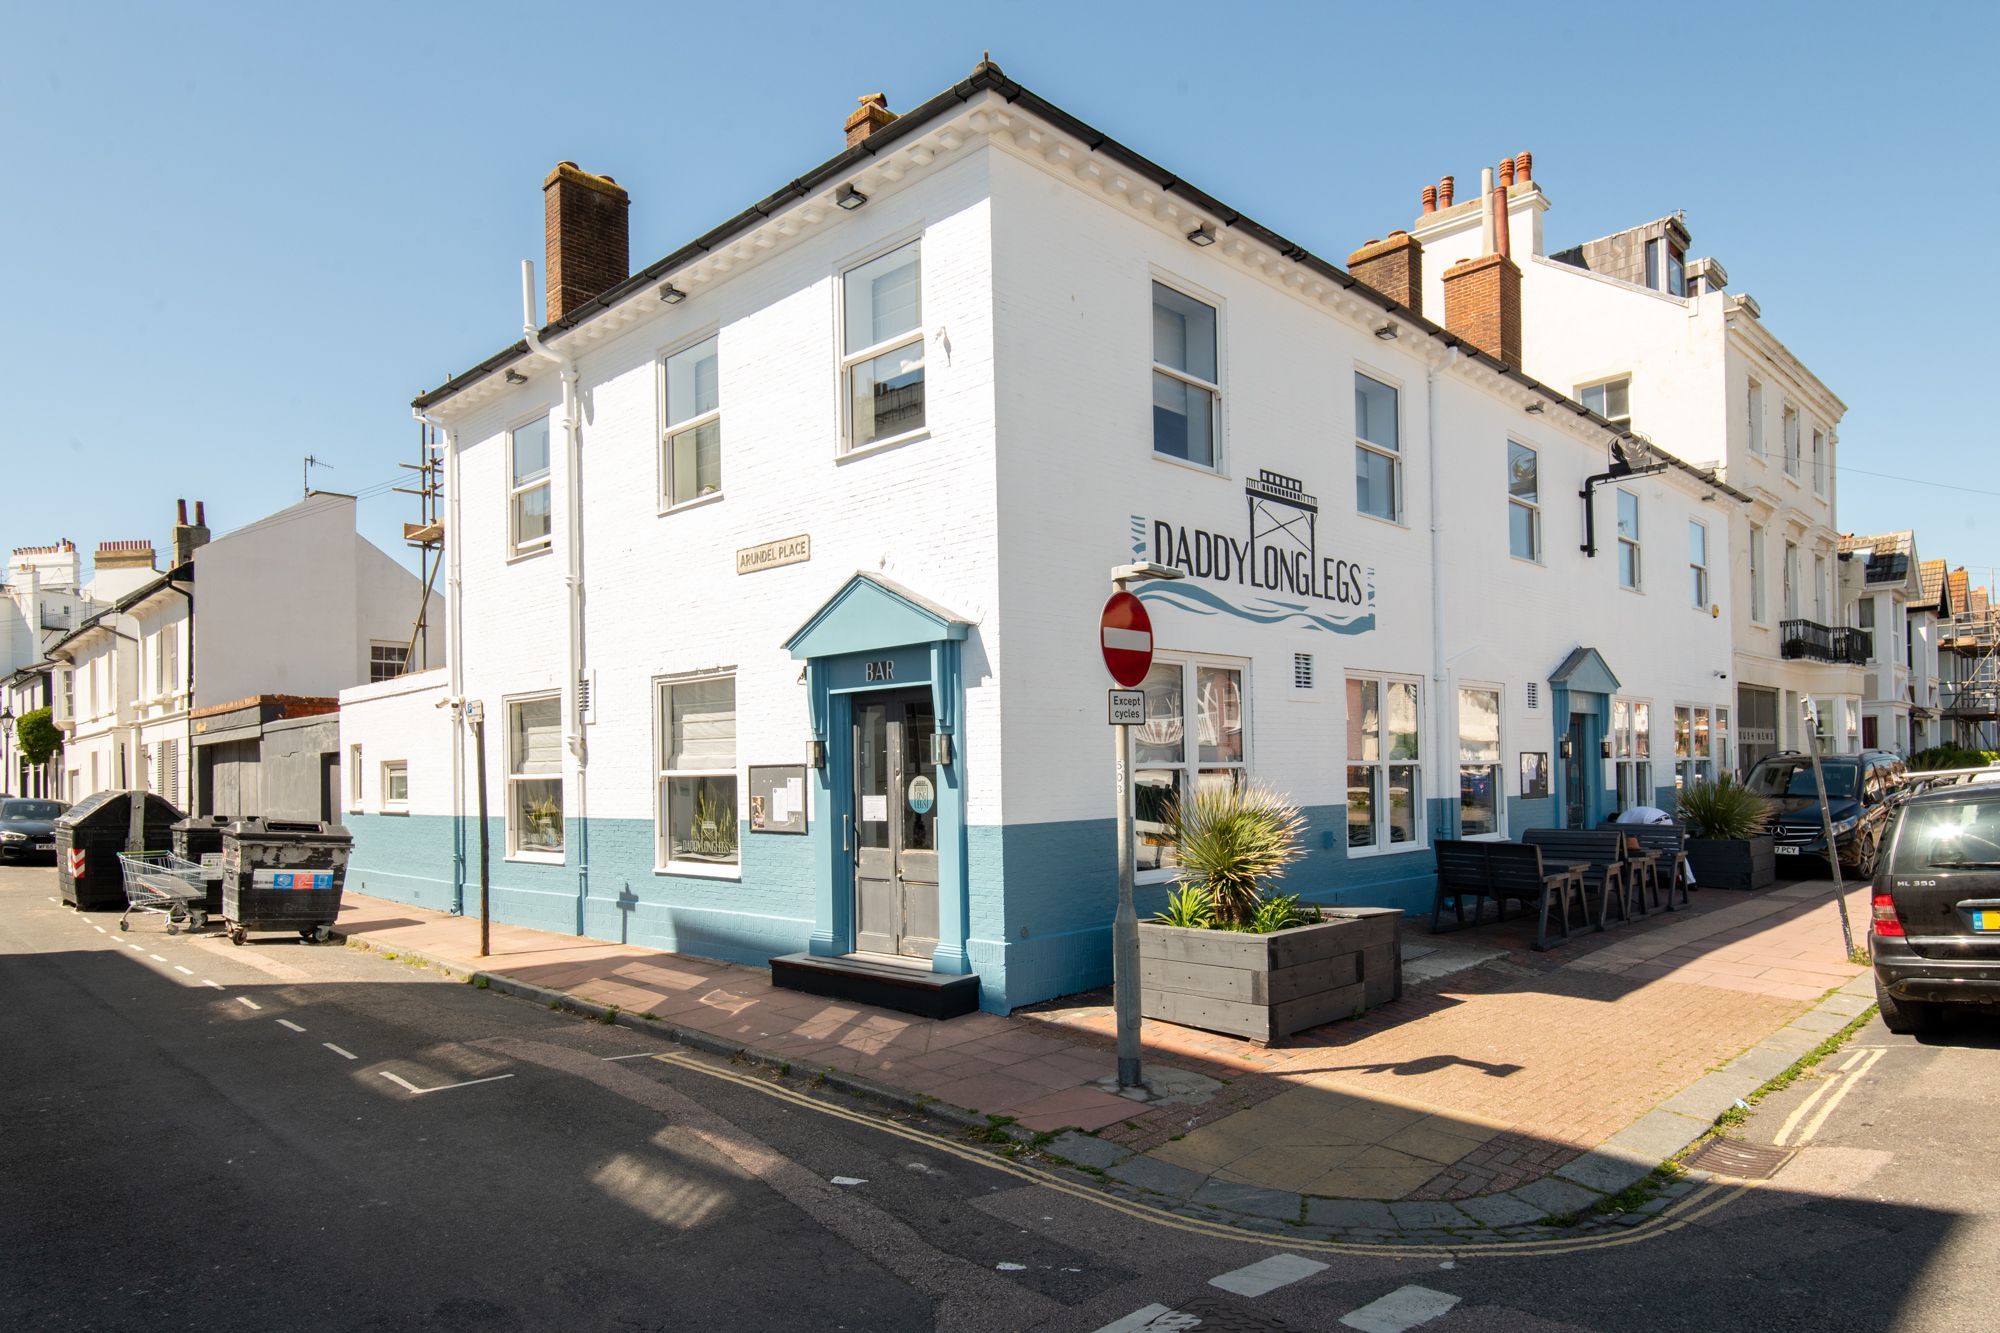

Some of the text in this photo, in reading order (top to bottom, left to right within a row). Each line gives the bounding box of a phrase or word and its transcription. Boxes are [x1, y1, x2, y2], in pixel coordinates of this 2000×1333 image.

[740, 541, 806, 568] ARUNDEL PLACE
[865, 660, 895, 682] BAR
[1113, 696, 1141, 707] Except
[1114, 709, 1140, 720] cycles
